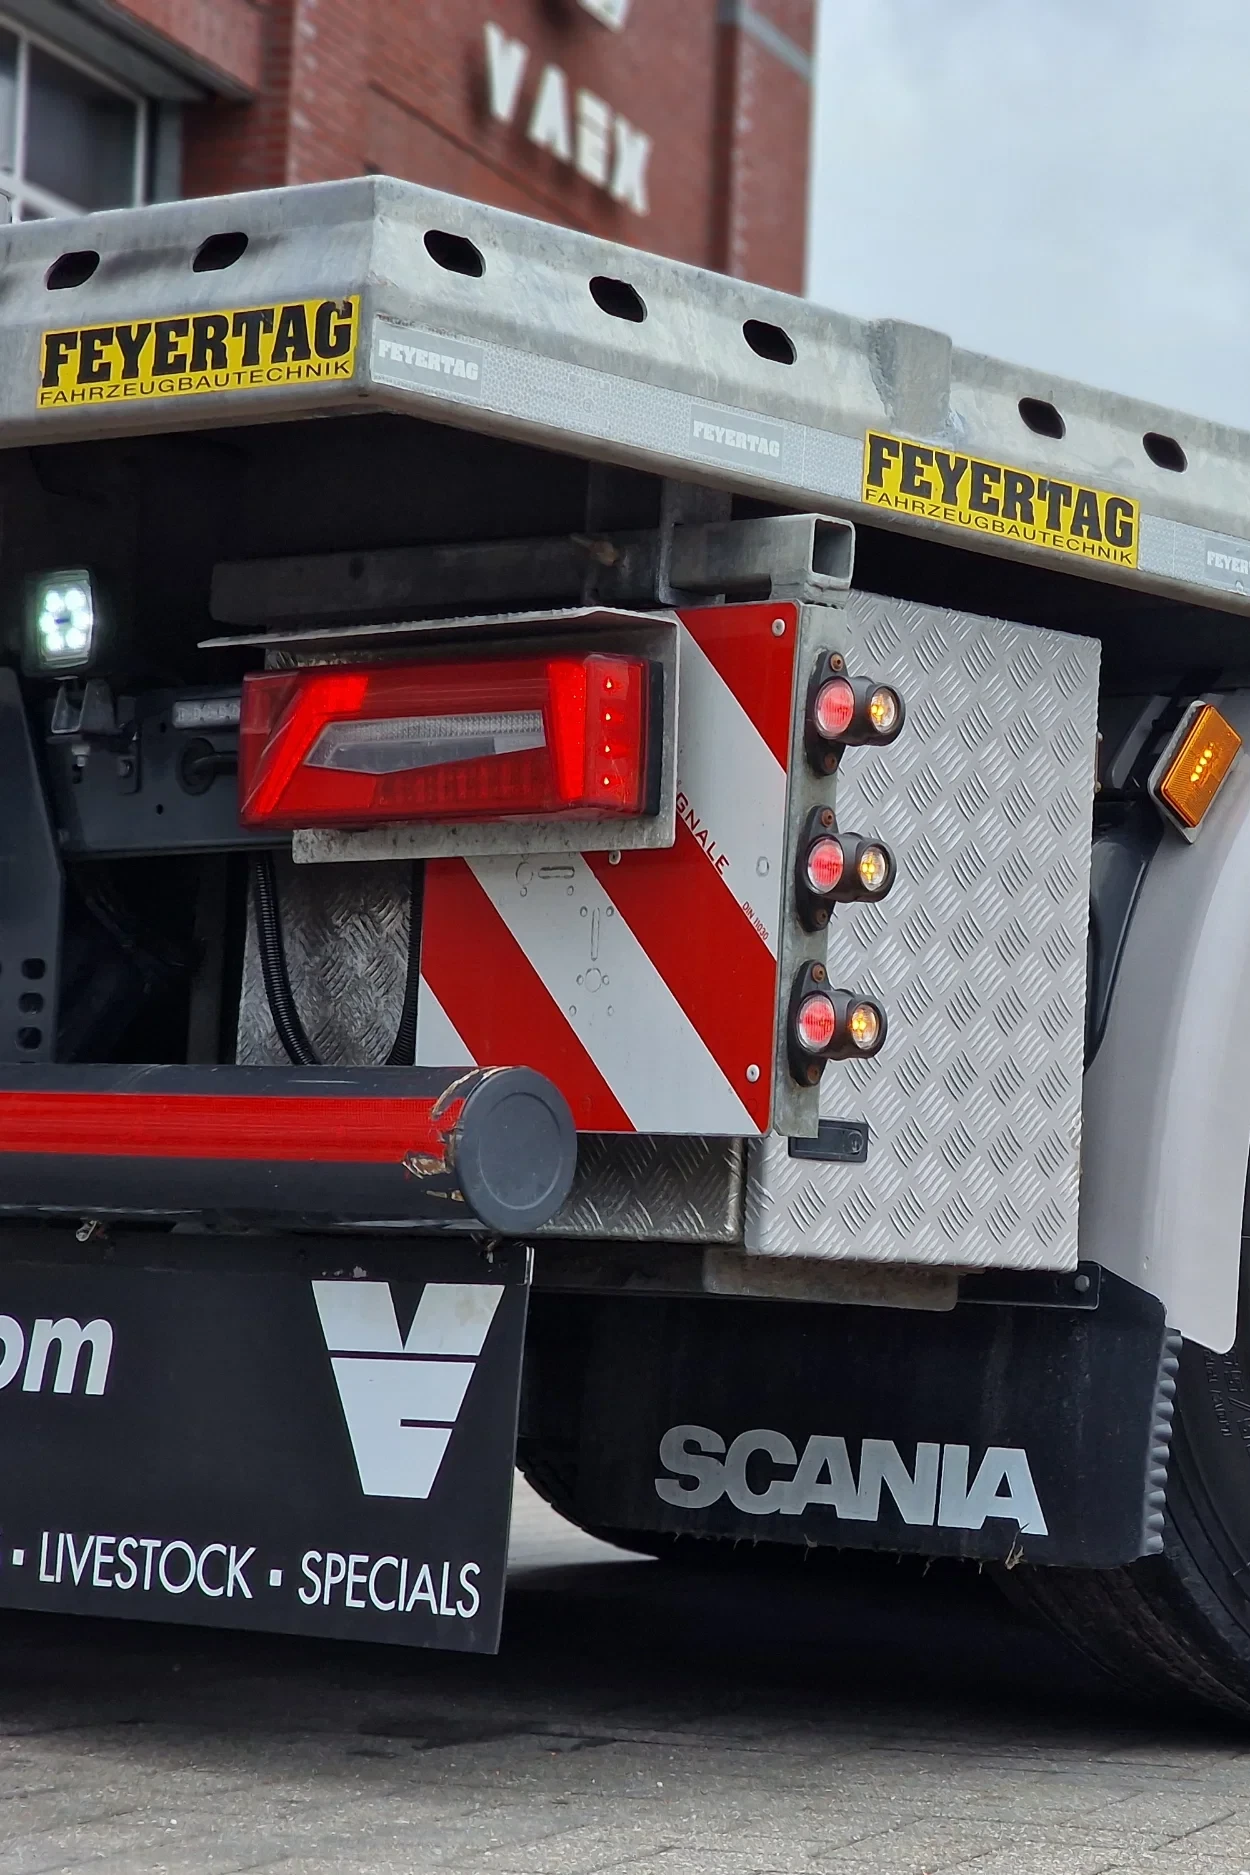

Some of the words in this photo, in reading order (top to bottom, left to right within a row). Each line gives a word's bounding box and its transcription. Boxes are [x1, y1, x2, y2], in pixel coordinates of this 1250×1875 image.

[484, 20, 654, 217] VAEX
[39, 360, 351, 406] FAHRZEUGBAUTECHNIK
[43, 302, 353, 388] FEYERTAG
[378, 339, 478, 381] FEYERTAG
[692, 420, 780, 457] FEYERTAG
[865, 487, 1133, 564] FAHRZEUGBAUTECHNIK
[866, 434, 1135, 548] FEYERTAG
[742, 901, 755, 920] DIN
[654, 1424, 1049, 1536] SCANIA
[38, 1531, 257, 1599] LIVESTOCK
[298, 1550, 482, 1619] SPECIALS
